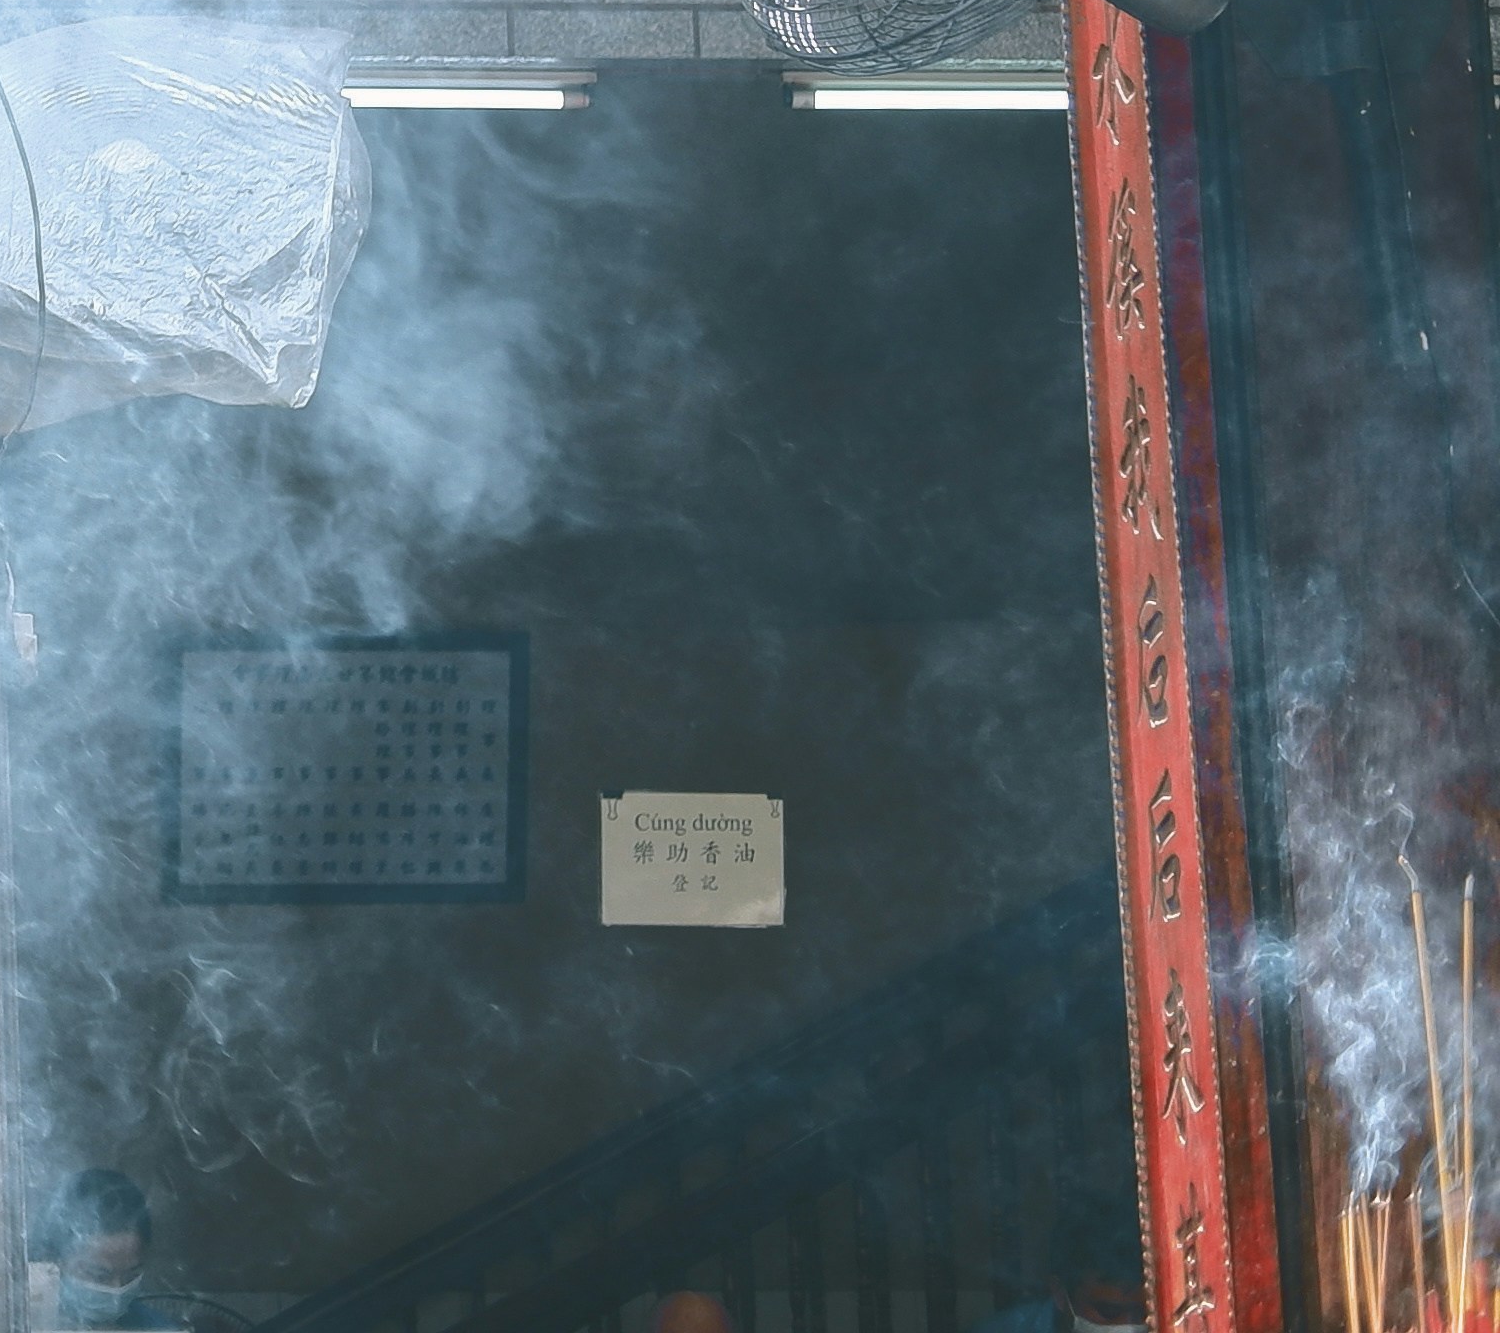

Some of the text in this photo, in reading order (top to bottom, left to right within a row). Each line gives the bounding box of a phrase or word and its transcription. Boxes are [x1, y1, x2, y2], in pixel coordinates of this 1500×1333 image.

[635, 812, 753, 836] Cúng dường
[633, 840, 755, 865] 樂助香油
[672, 874, 718, 892] 登記
